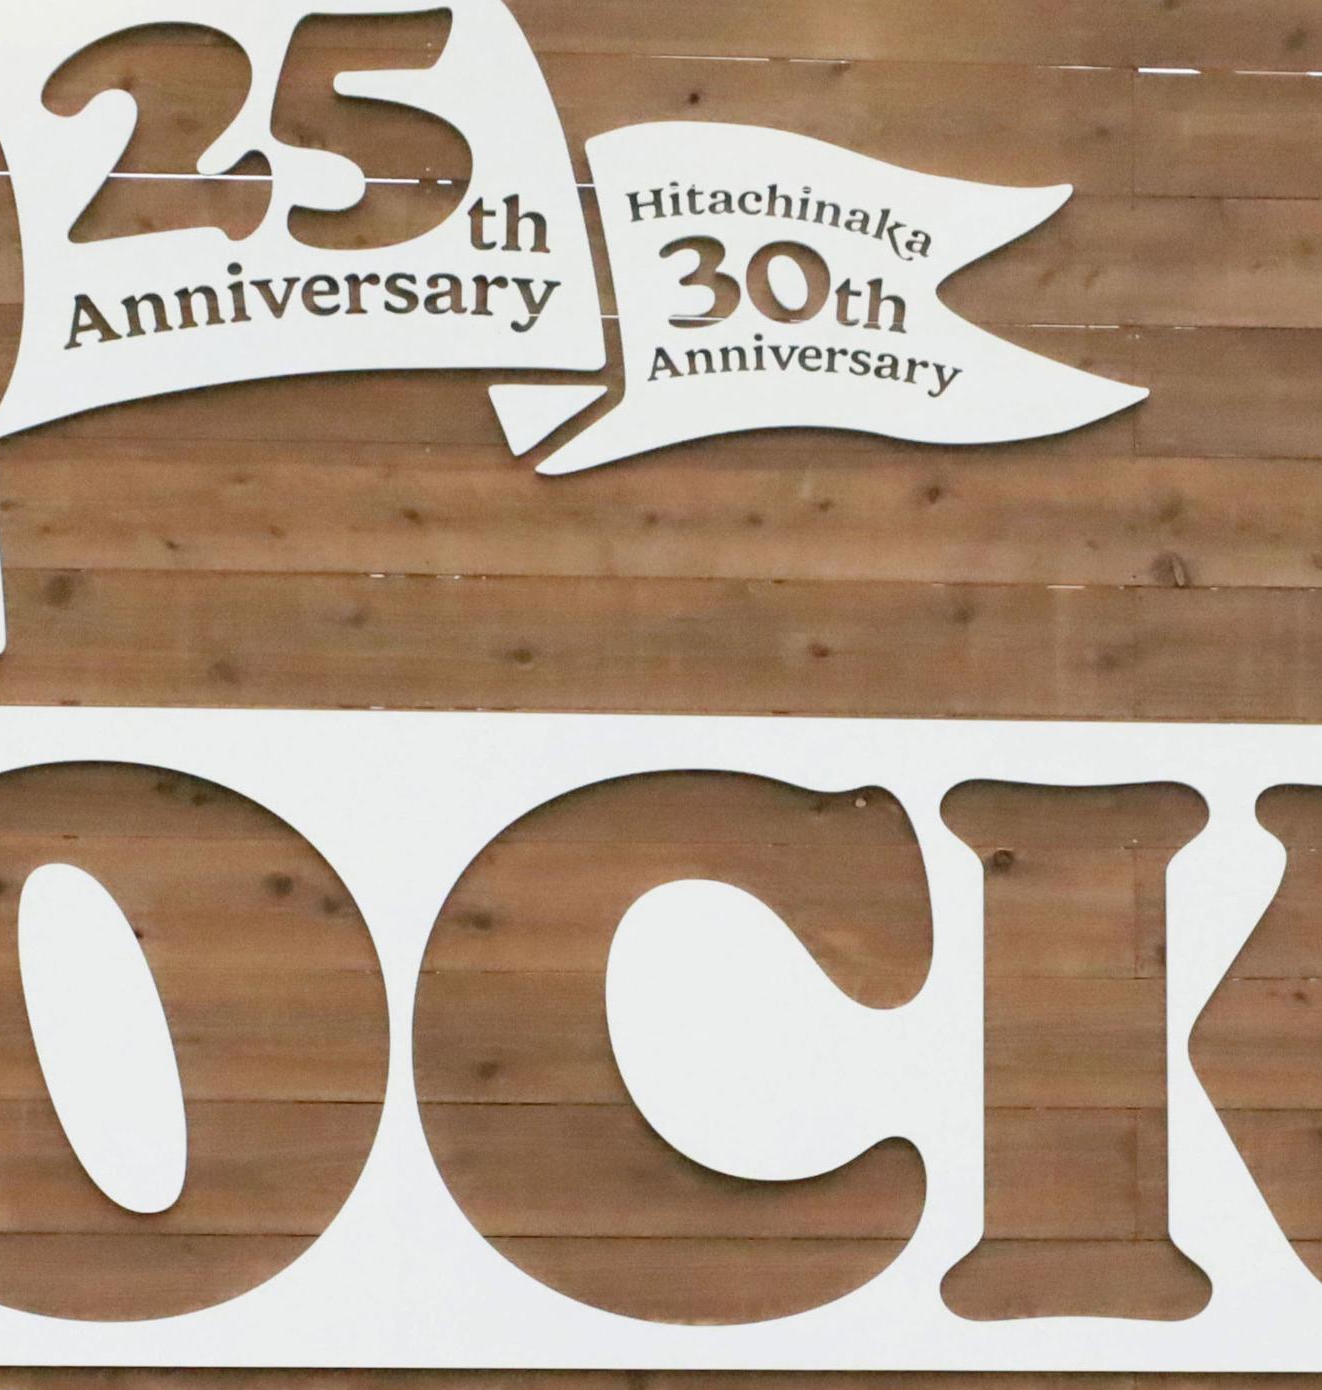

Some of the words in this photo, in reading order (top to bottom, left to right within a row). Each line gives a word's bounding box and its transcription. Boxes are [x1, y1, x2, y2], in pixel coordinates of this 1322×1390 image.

[40, 6, 551, 254] 25th
[625, 183, 933, 260] Hitachinaka
[63, 261, 563, 352] Anniversary
[658, 235, 908, 335] 30th
[647, 334, 964, 398] Anniversary
